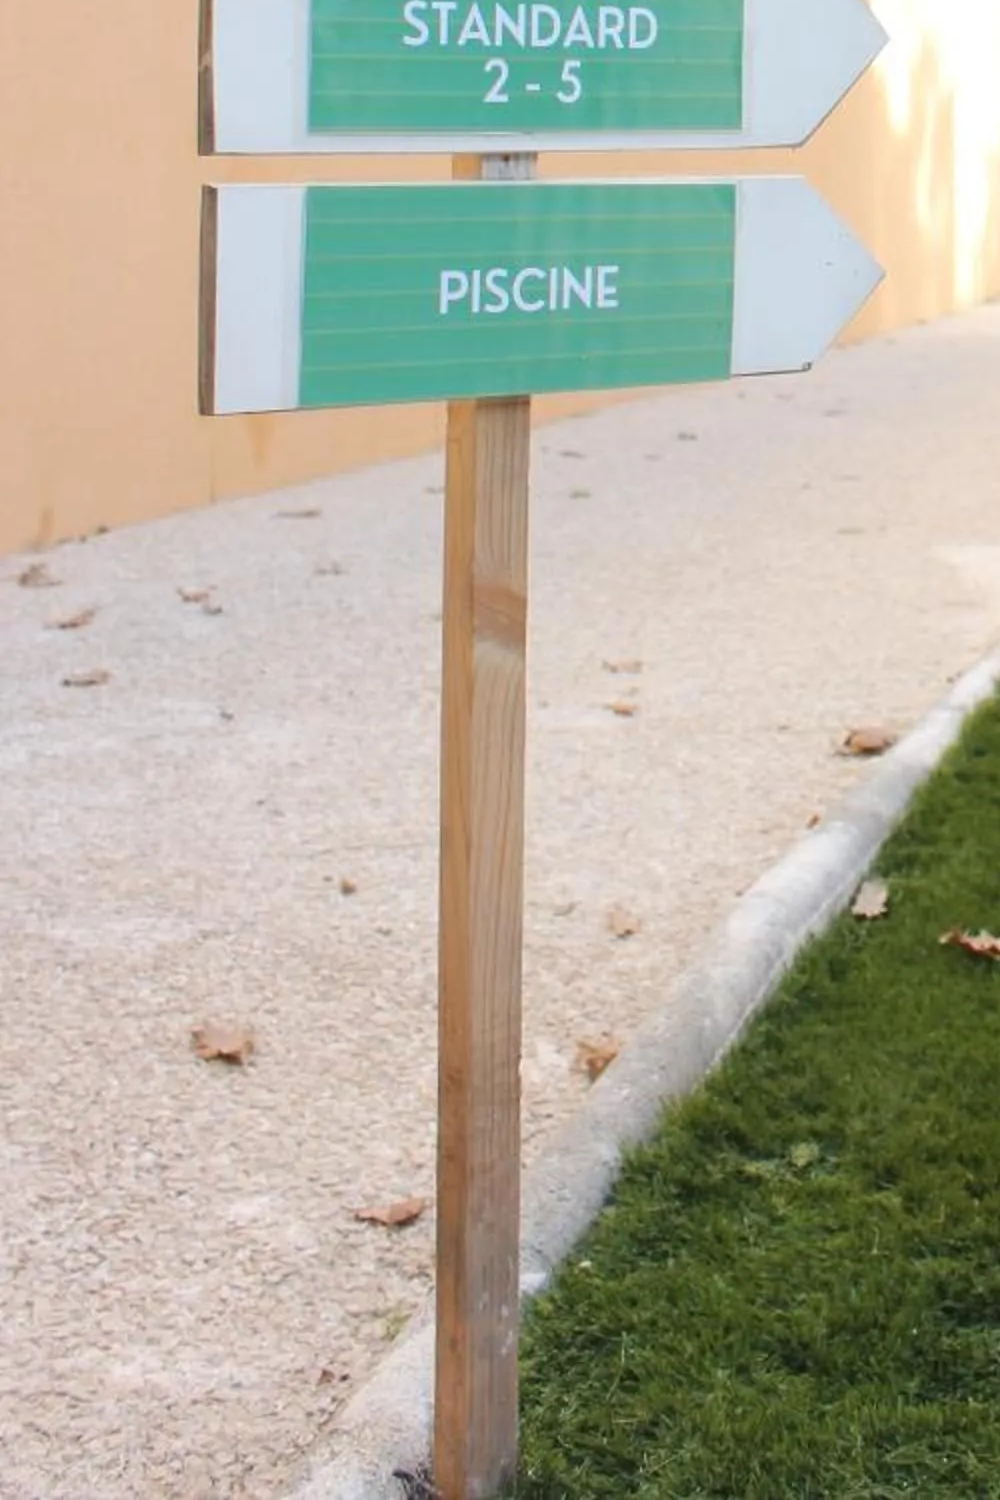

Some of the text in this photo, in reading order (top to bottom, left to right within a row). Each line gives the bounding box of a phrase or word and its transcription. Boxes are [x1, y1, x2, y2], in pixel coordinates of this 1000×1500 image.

[402, 0, 658, 49] STANDARD
[483, 58, 509, 103] 2
[556, 59, 582, 103] 5
[439, 265, 620, 313] PISCINE
